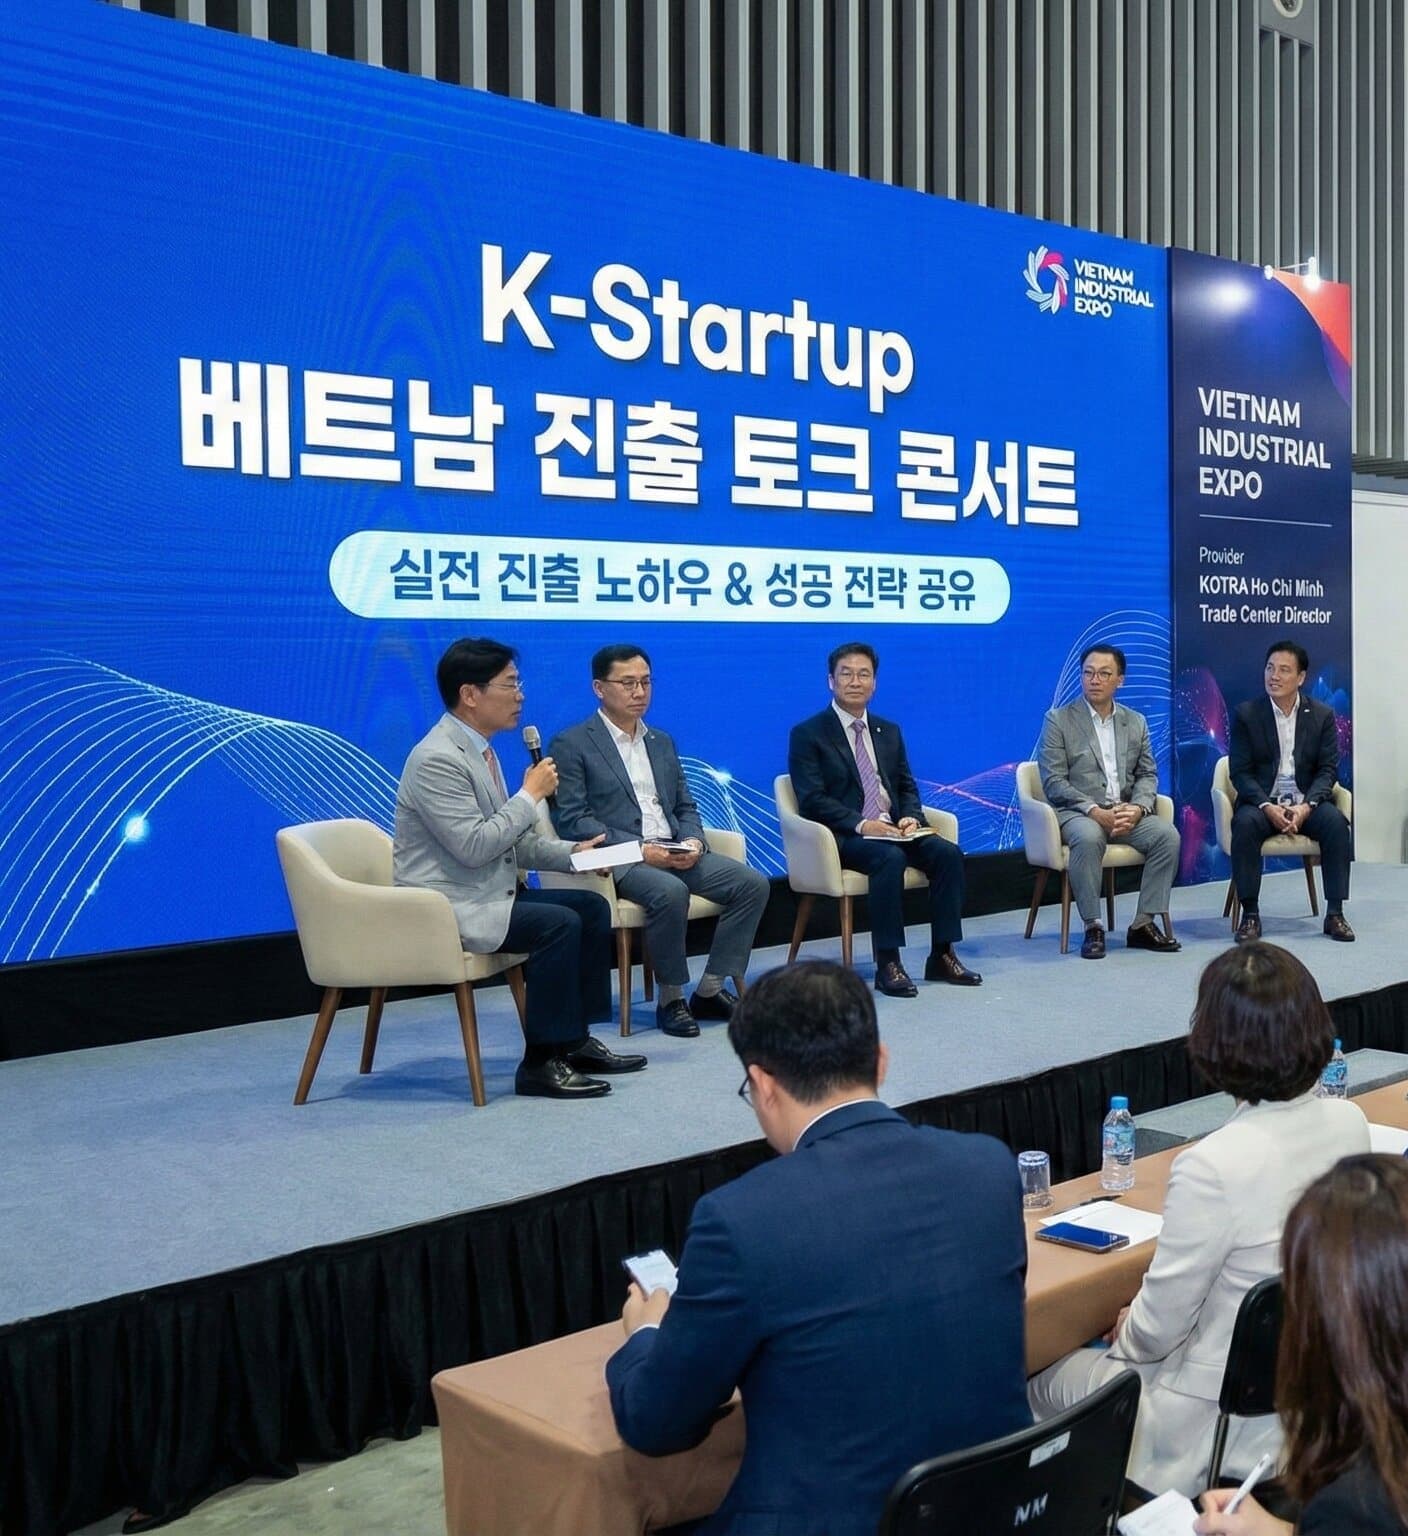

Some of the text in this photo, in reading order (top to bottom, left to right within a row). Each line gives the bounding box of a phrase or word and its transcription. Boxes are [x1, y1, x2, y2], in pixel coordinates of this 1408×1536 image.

[1074, 259, 1133, 285] VIETNAM
[1074, 279, 1154, 308] INDUSTRIAL
[1075, 299, 1112, 318] EXPO
[479, 243, 914, 413] K-Startup
[1198, 387, 1301, 428] VIETNAM
[178, 356, 1078, 525] 베트남 진출 토크 콘서트
[1199, 427, 1332, 469] INDUSTRIAL
[1200, 467, 1262, 499] EXPO
[1200, 547, 1244, 564] Provider
[390, 549, 975, 611] 실전 진출 노하우 & 성공 전략 공유
[1200, 576, 1323, 597] KOTRA Ho Chi Minh
[1200, 604, 1332, 624] Trade Center Director
